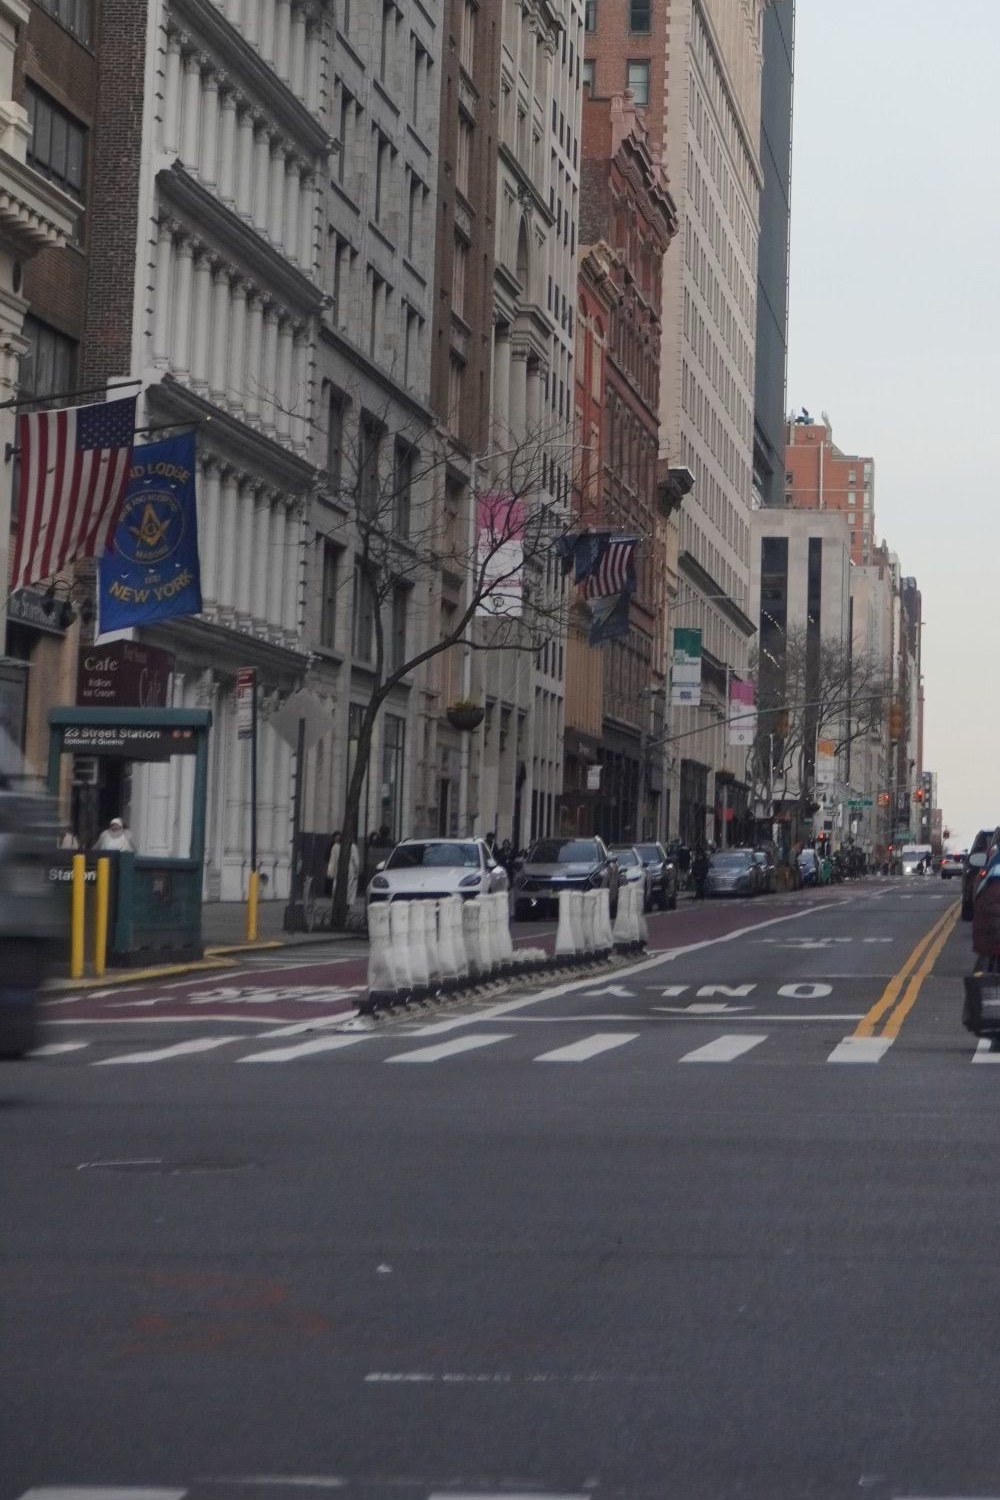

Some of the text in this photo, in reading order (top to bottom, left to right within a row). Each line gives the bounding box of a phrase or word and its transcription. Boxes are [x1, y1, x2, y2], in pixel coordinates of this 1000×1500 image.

[148, 462, 190, 484] LODGE
[110, 569, 192, 603] NEW YORK
[64, 727, 80, 738] 23
[81, 727, 117, 738] Street
[118, 728, 160, 739] Station
[48, 868, 97, 882] Statn
[576, 982, 834, 999] ONLY
